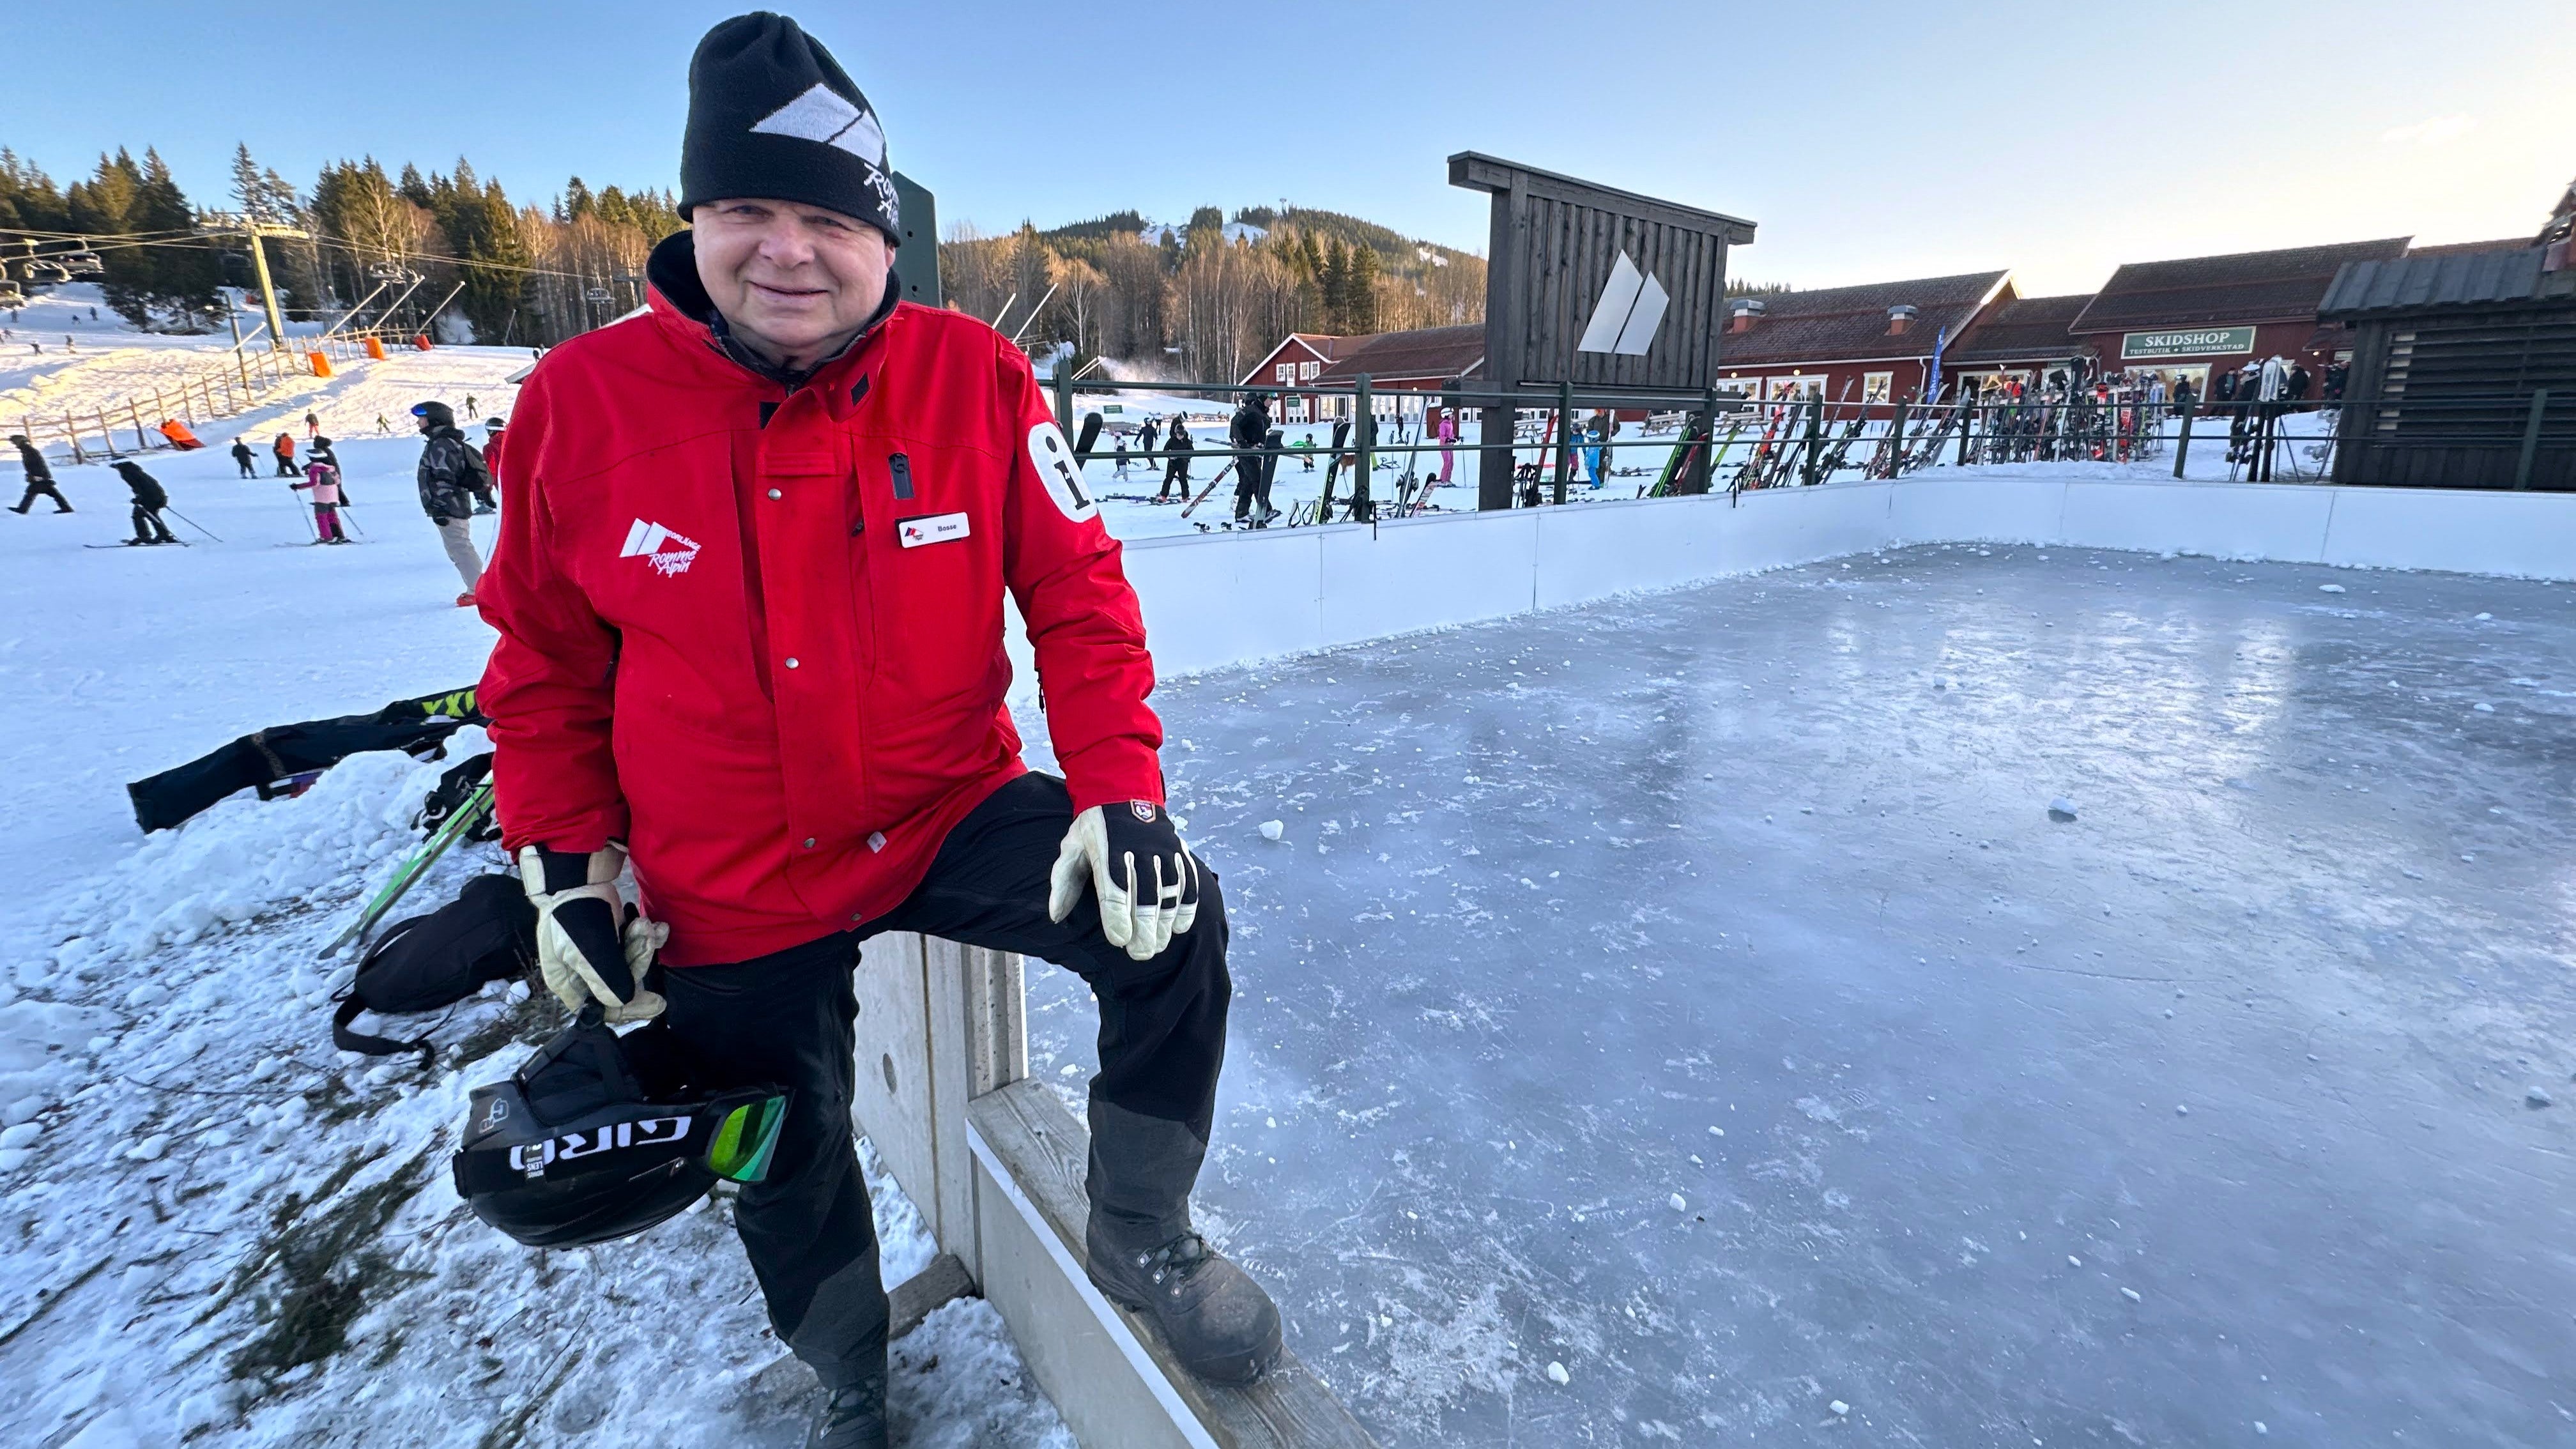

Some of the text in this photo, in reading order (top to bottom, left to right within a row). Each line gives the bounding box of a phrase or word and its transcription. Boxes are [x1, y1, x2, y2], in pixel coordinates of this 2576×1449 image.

[2145, 332, 2230, 347] SKIDSHOP
[2182, 344, 2244, 353] SKIDVERKSTAD
[648, 551, 697, 569] Romme
[509, 1116, 692, 1170] GIRO
